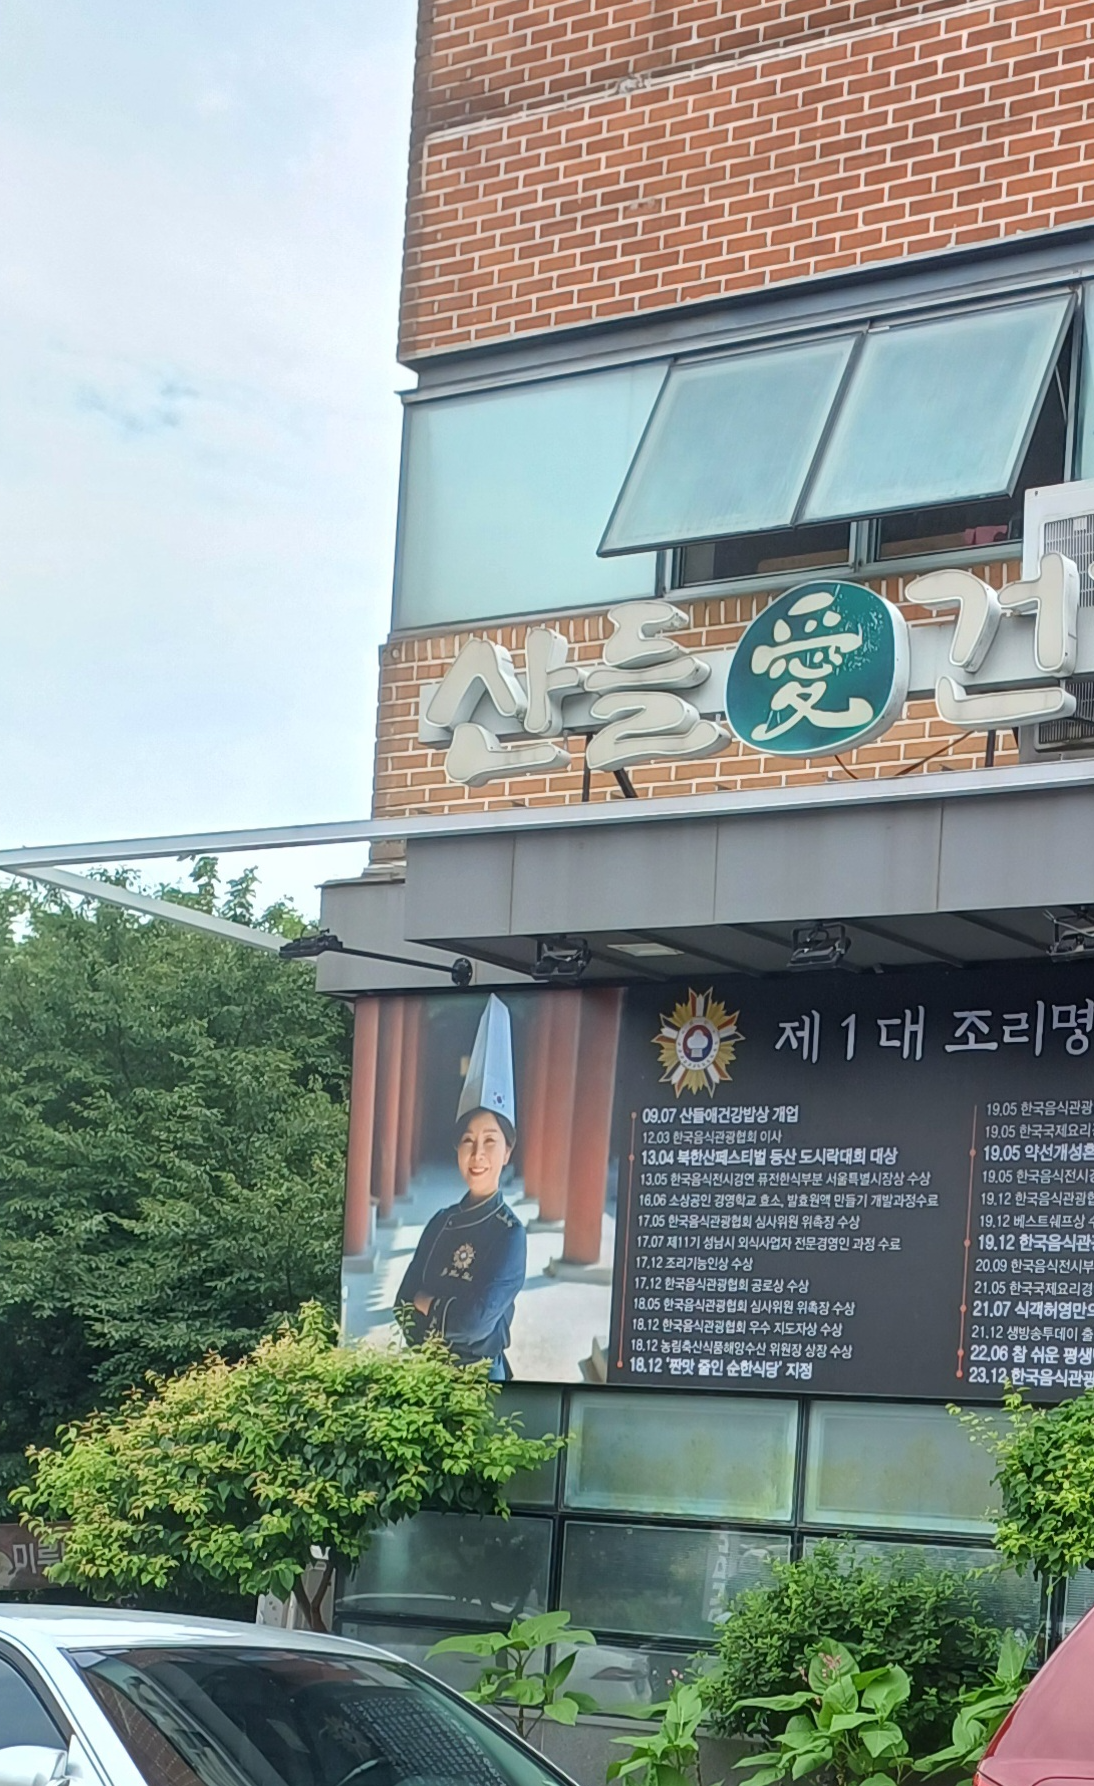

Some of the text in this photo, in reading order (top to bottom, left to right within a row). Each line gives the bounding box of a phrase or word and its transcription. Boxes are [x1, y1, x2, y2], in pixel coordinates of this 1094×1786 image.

[642, 1105, 798, 1124] 09.07 산들애건강밥상 개업
[986, 1102, 1017, 1116] 19.05
[642, 1129, 782, 1145] 12.03 한국음식관광협회 이사
[985, 1124, 1016, 1138] 19.05
[641, 1149, 674, 1165] 13.04
[769, 1148, 797, 1166] 등산
[798, 1147, 866, 1165] 도시락대회
[870, 1147, 898, 1165] 대상
[983, 1144, 1021, 1161] 19.05
[640, 1172, 668, 1186] 13.05
[670, 1172, 755, 1186] 한국음식전시경연
[825, 1171, 905, 1186] 서울특별시장상
[906, 1171, 931, 1186] 수상
[982, 1169, 1013, 1183] 19.05
[668, 1193, 711, 1208] 소상공인
[713, 1193, 757, 1208] 경영학교
[787, 1193, 831, 1208] 발효원액
[833, 1193, 868, 1208] 만들기
[870, 1194, 939, 1208] 개발과정수료
[981, 1191, 1011, 1205] 19.12
[638, 1214, 860, 1230] 17.05 한국음식관광협회 심사위원 위촉장 수상
[980, 1214, 1010, 1228] 19.12
[1013, 1214, 1086, 1229] 베스트쉐프상
[637, 1235, 901, 1251] 17.07 제11기 성남시 외식사업자 전문경영인 과정 수료
[978, 1234, 1015, 1250] 19.12
[636, 1255, 753, 1271] 17.12 조리기능인상 수상
[975, 1258, 1007, 1272] 20.09
[634, 1276, 809, 1293] 17.12 한국음식관광협회 공로상 수상
[974, 1280, 1006, 1294] 21.05
[633, 1297, 855, 1316] 18.05 한국음식관광협회 심사위원 위촉장 수상
[972, 1300, 1012, 1318] 21.07
[632, 1317, 843, 1337] 18.12 한국음식관광협회 우수 지도자상 수상
[971, 1324, 1003, 1339] 21.12
[1006, 1326, 1078, 1341] 생방송투데이
[631, 1338, 658, 1351] 18.12
[769, 1342, 802, 1357] 위원장
[804, 1343, 827, 1358] 상장
[829, 1344, 852, 1359] 수상
[970, 1344, 1008, 1361] 22.06
[1011, 1345, 1028, 1363] 참
[1030, 1346, 1060, 1364] 쉬운
[629, 1356, 662, 1373] 18.12
[785, 1362, 812, 1379] 지정
[968, 1367, 1007, 1383] 23.12
